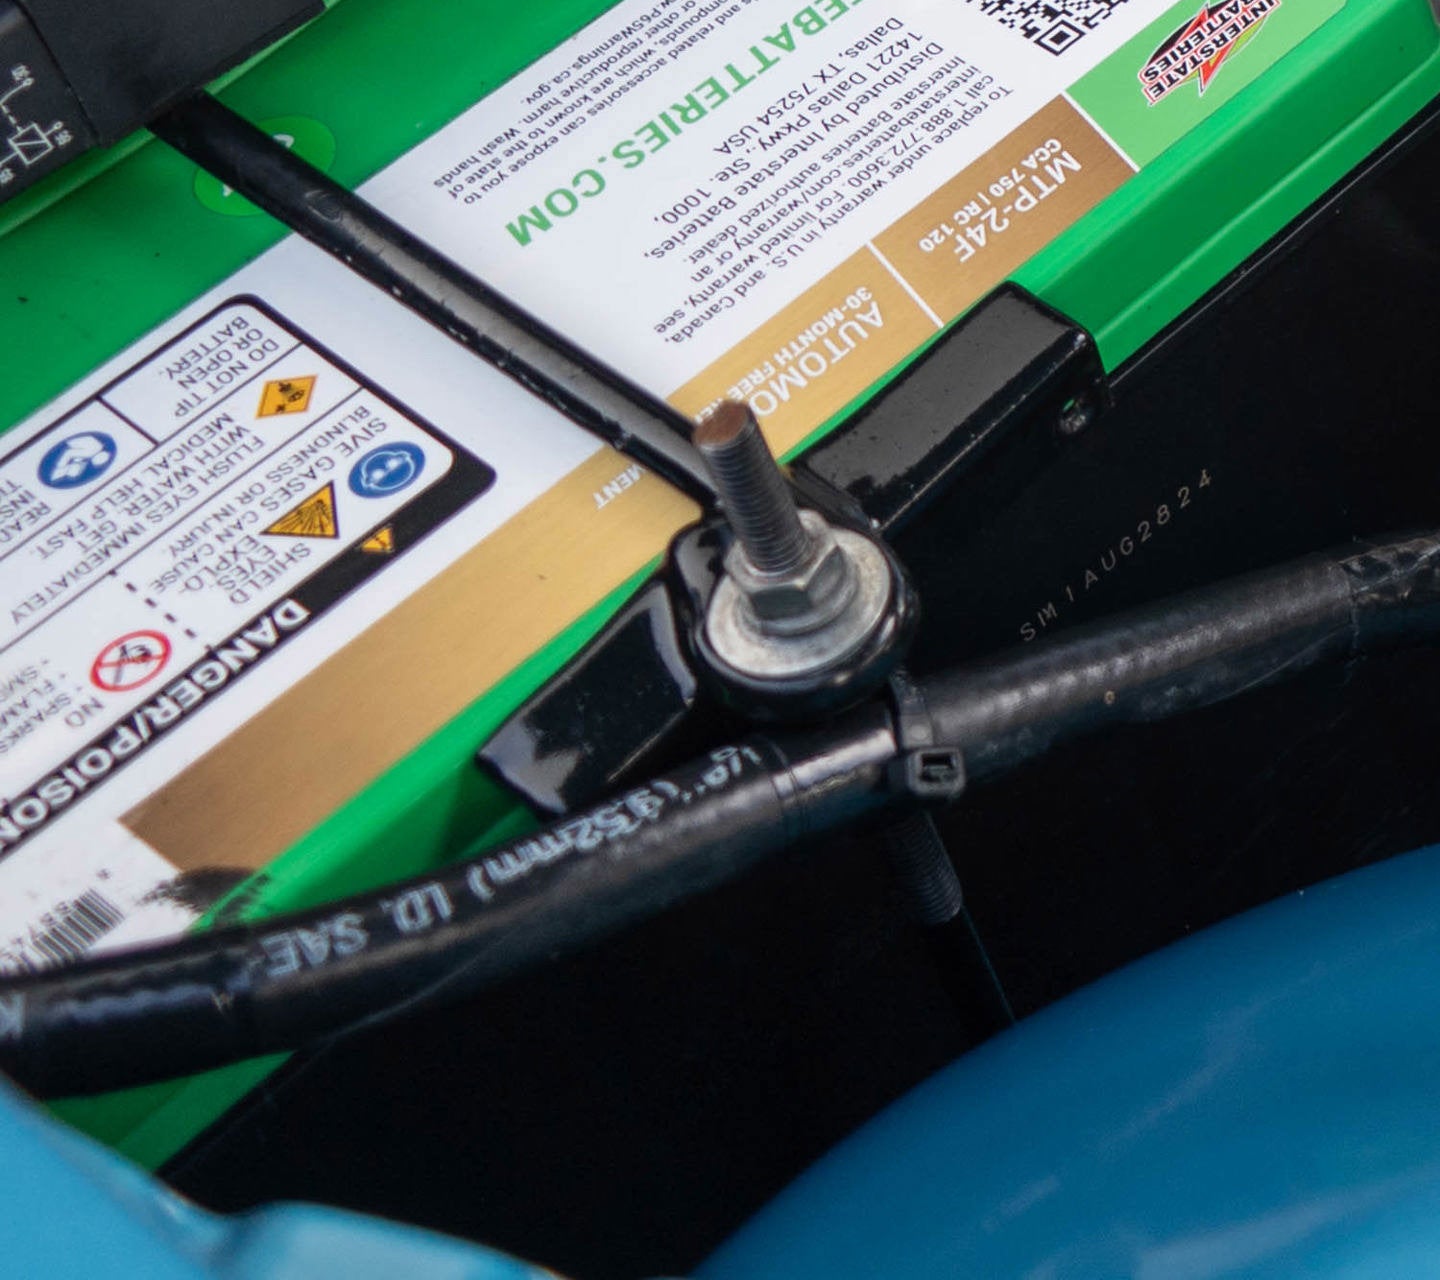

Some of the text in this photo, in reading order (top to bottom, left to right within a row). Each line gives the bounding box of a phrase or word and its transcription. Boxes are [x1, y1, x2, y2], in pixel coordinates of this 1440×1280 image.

[643, 11, 681, 39] other
[679, 0, 696, 12] or
[713, 3, 742, 26] and
[666, 22, 716, 60] related
[557, 36, 645, 98] reproductive
[613, 47, 657, 78] which
[585, 57, 668, 116] accessories
[589, 76, 614, 94] are
[712, 16, 904, 155] Dallas, TX 75254 USA
[517, 96, 563, 126] harm.
[543, 93, 593, 128] known
[558, 115, 586, 136] can
[653, 30, 923, 226] 14221 Dallas Pkwy., Ste. 1000,
[477, 127, 521, 156] Wash
[501, 138, 529, 158] the
[506, 134, 559, 172] expose
[526, 126, 546, 140] to
[643, 41, 944, 260] Distributed by Interstate Batteries,
[1020, 138, 1063, 169] CCA
[432, 154, 481, 188] hands
[464, 156, 503, 184] state
[478, 169, 509, 192] you
[683, 55, 966, 266] Interstate Batteries authorized dealer.
[690, 63, 981, 282] interstatebatteries.com/warranty or an
[446, 183, 466, 200] of
[462, 191, 482, 204] to
[987, 167, 1026, 197] 750
[652, 74, 996, 333] call 1.888.772.3600. For limited warranty, see
[664, 84, 1013, 345] To replace under warranty in U.S. and Canada,
[947, 150, 1084, 263] MTP-24F
[951, 199, 984, 225] RC
[917, 223, 956, 252] 120
[771, 284, 873, 367] 30-MONTH
[154, 315, 251, 385] BATTERY.
[176, 327, 264, 390] OR OPEN
[171, 337, 280, 418] DO NOT TIP
[725, 359, 775, 403] FREE
[27, 411, 234, 563] MEDICAL HELP FAST.
[74, 424, 250, 554] WITH WATER. GET
[159, 404, 371, 561] BLINDNESS OR INJURY.
[149, 416, 388, 594] SIVE GASES CAN CAUSE
[8, 433, 265, 624] FLUSH EYES IMMEDIATELY
[169, 533, 261, 602] EXPLO-
[208, 543, 278, 596] EYES.
[227, 541, 311, 605] SHIELD
[62, 696, 105, 728] NO
